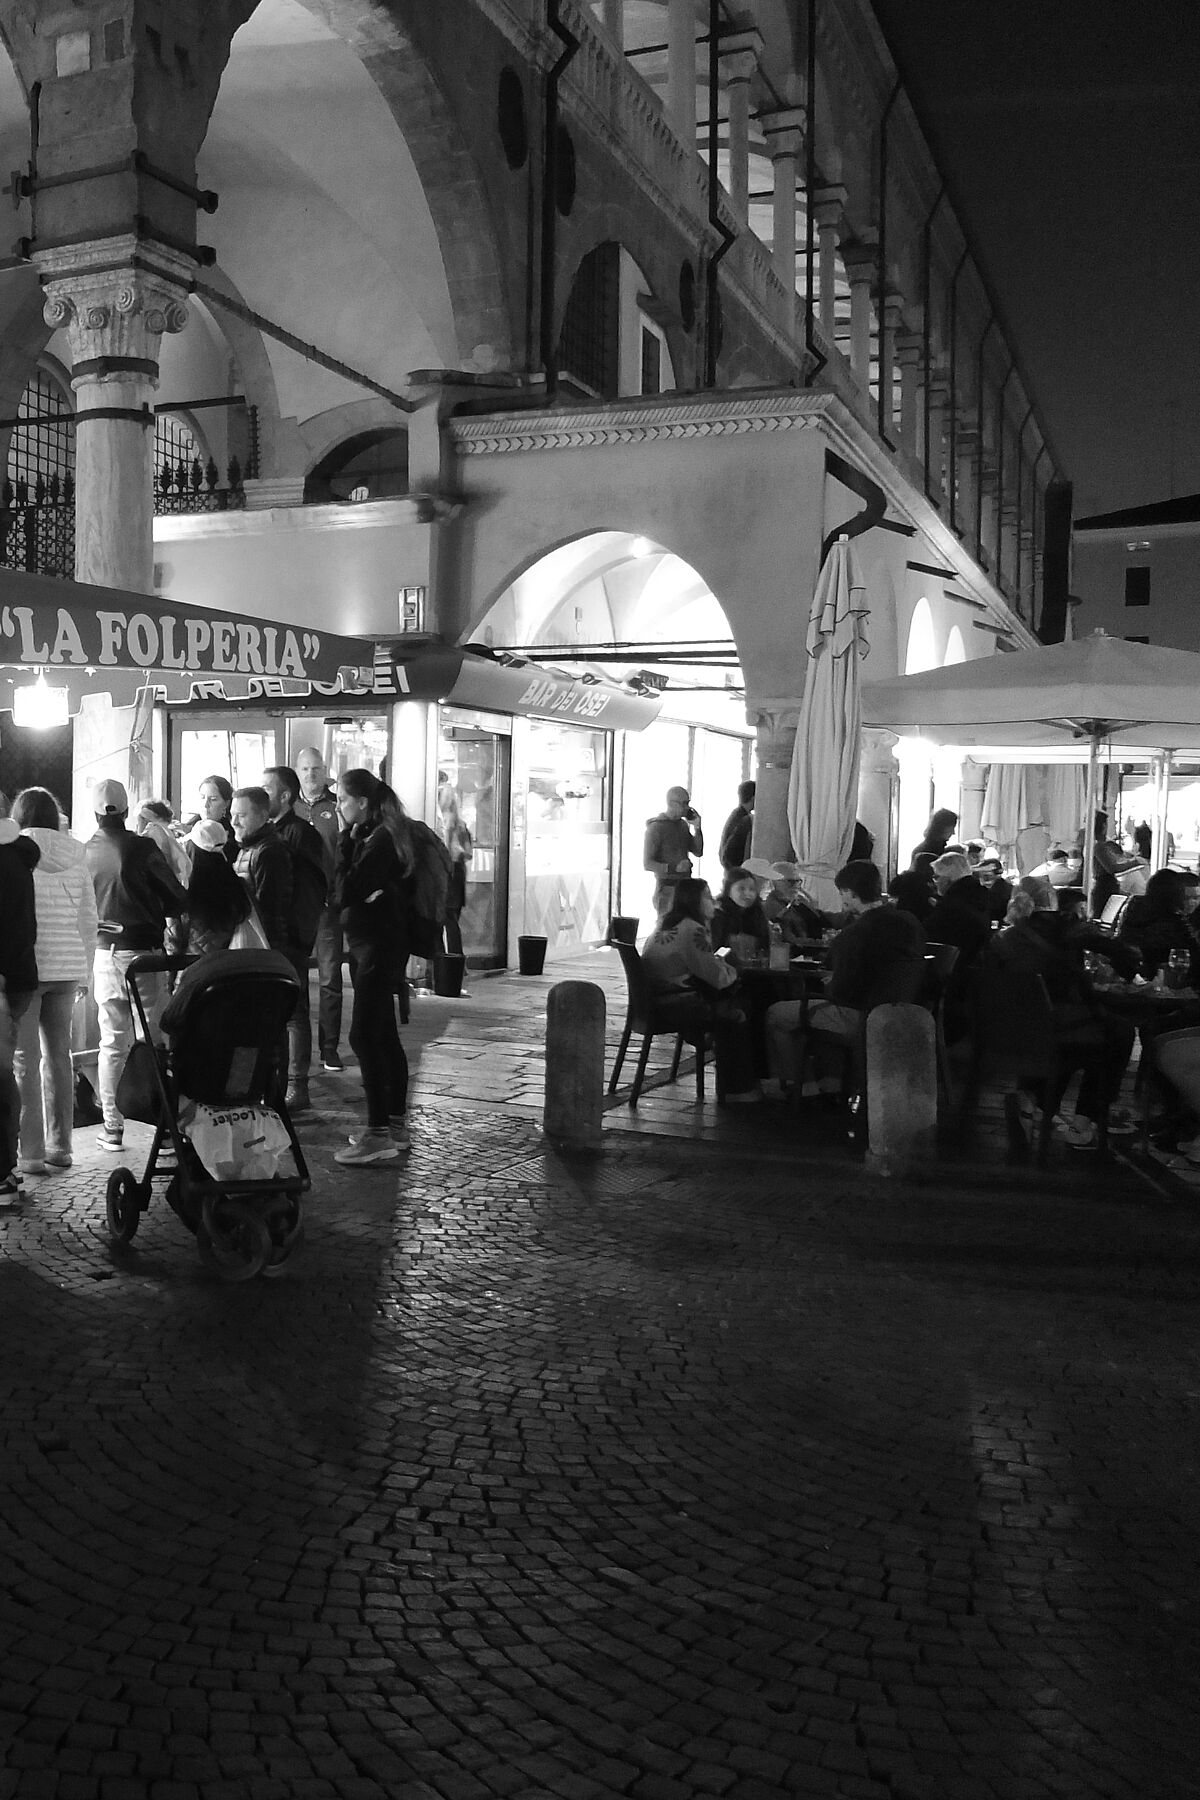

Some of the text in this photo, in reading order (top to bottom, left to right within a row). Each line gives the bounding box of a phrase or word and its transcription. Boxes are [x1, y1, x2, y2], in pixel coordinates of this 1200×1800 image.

[95, 610, 321, 678] FOLPERIA”
[518, 679, 611, 717] BAR DEI OSEI
[212, 1110, 257, 1127] Locker
